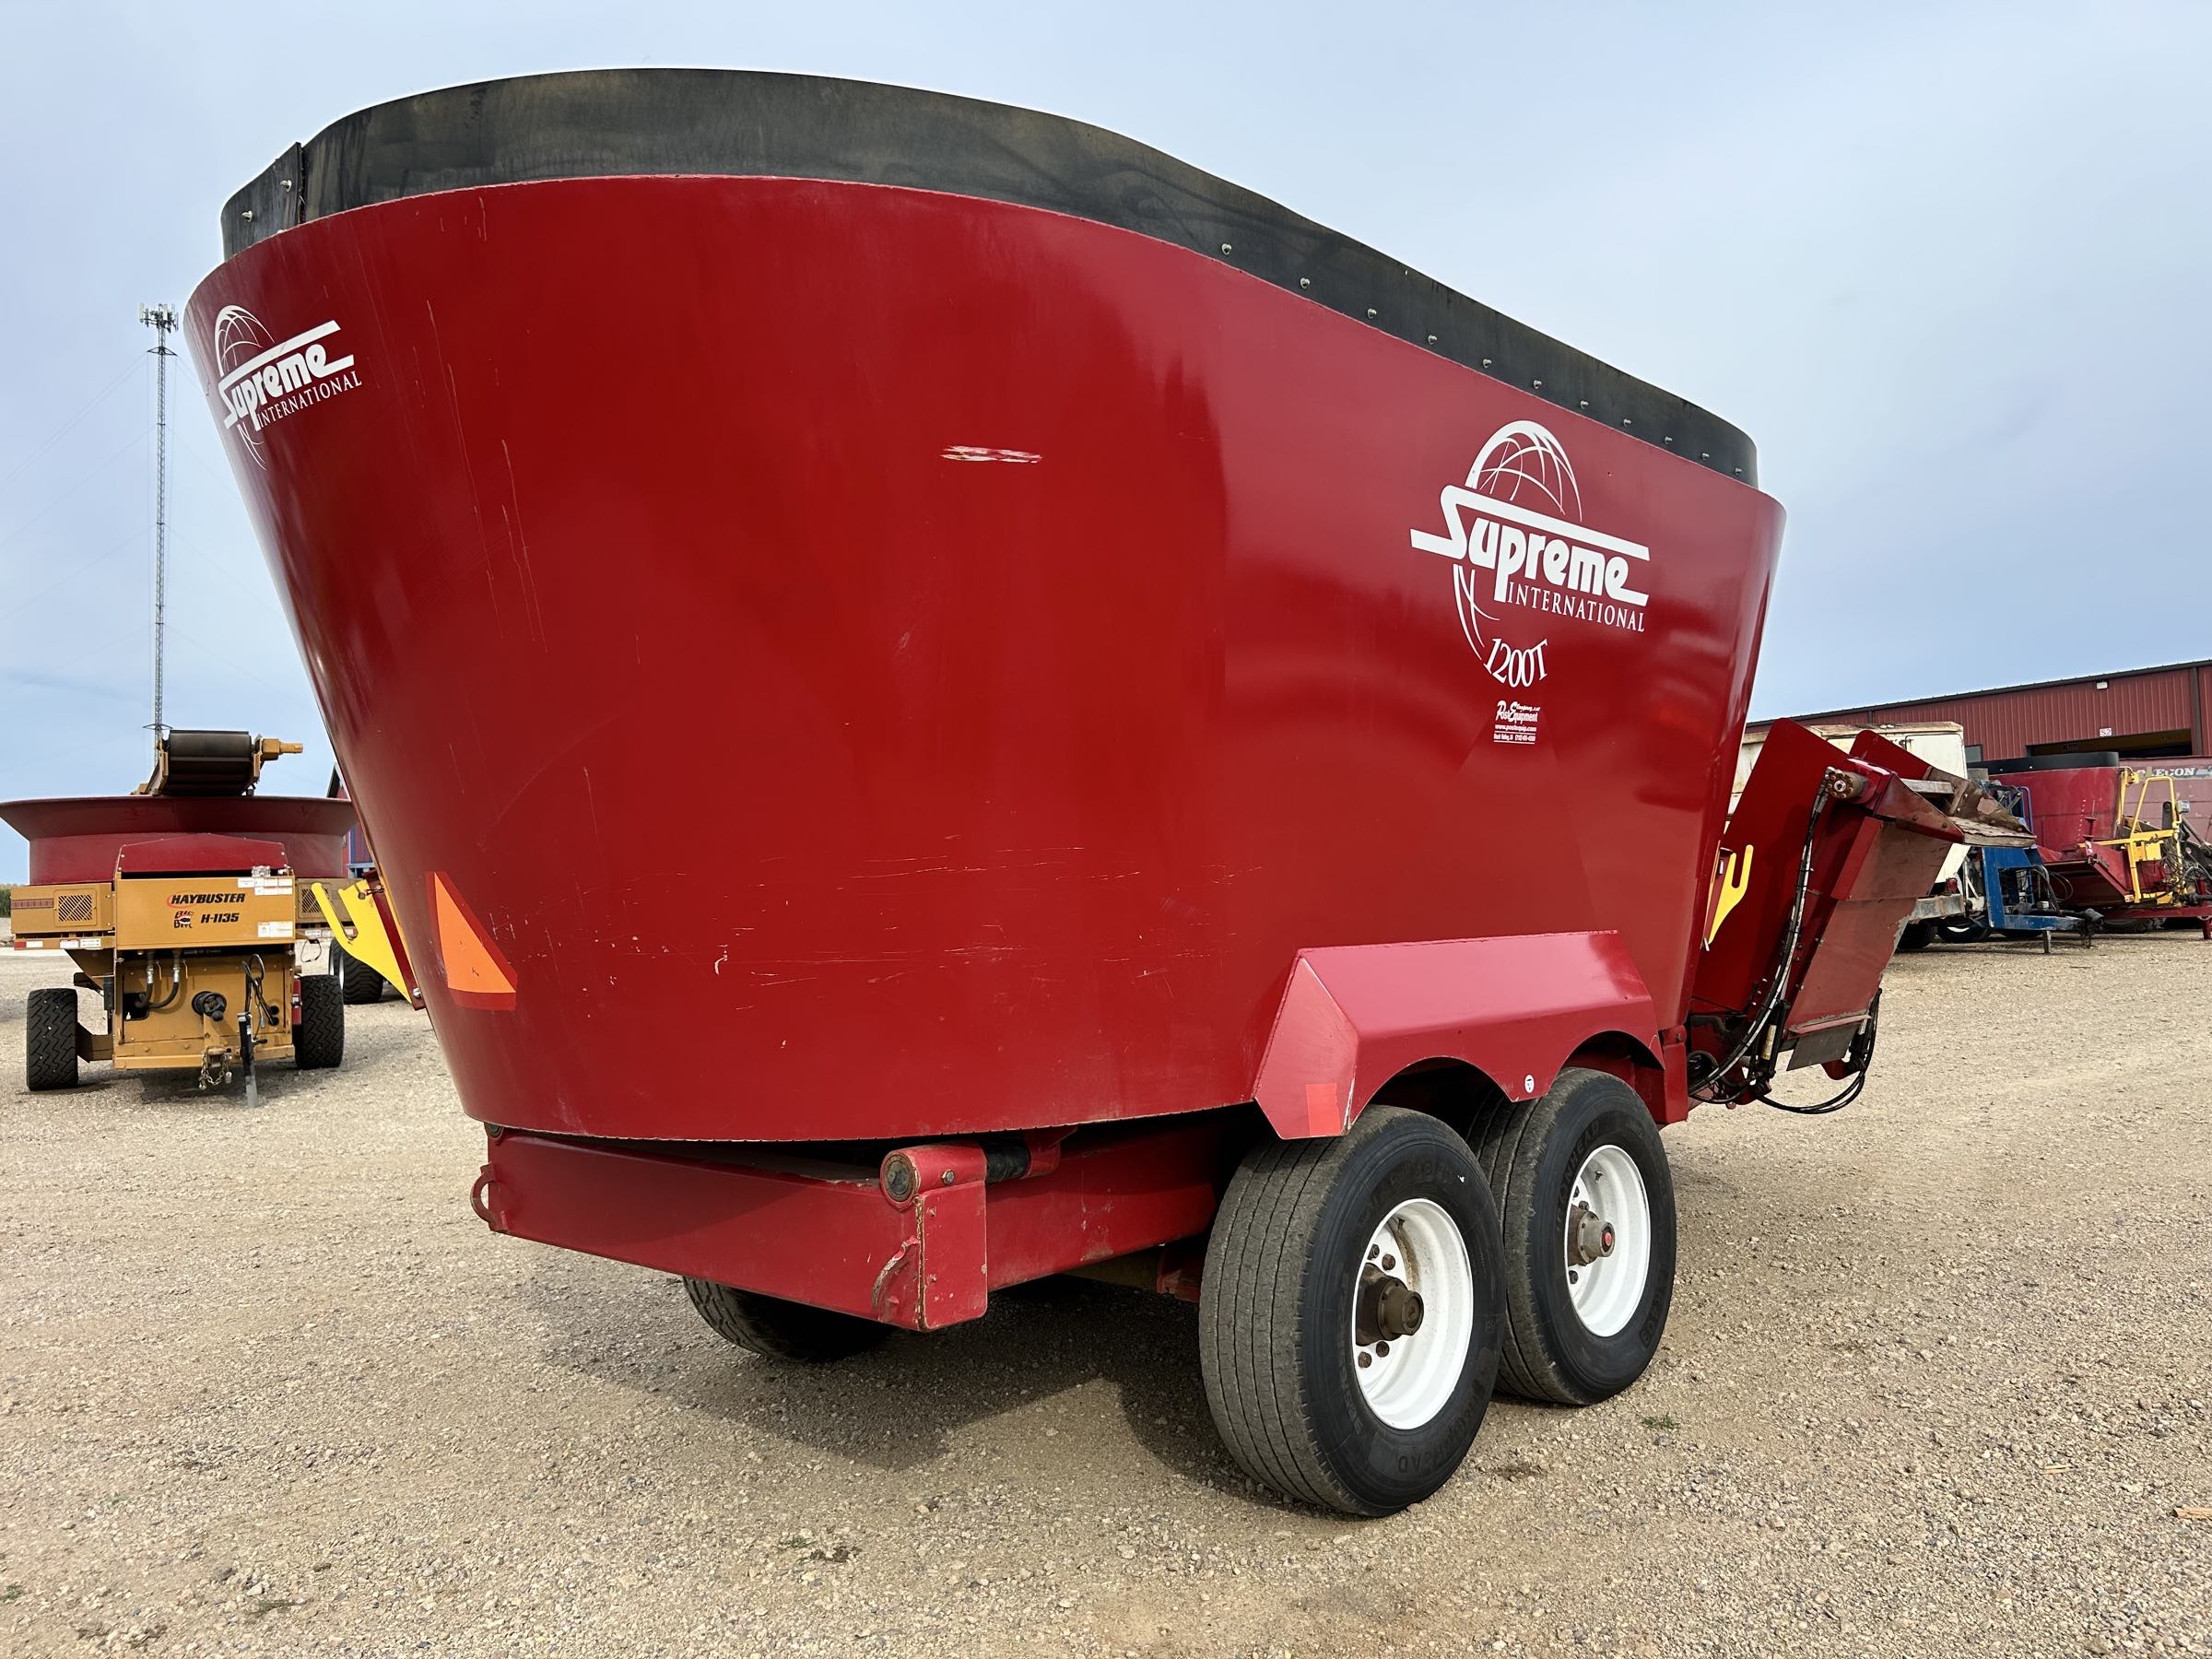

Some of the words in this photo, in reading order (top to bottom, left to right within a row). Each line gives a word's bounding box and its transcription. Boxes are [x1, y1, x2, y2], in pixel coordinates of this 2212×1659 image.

[218, 320, 355, 431] Supreme
[257, 371, 362, 428] INTERNATIONAL
[1410, 485, 1650, 606] Supreme
[1508, 582, 1645, 632] INTERNATIONAL
[1483, 638, 1548, 688] 1200T
[2100, 728, 2112, 736] S2
[171, 893, 246, 905] HAYBUSTER
[200, 912, 241, 924] H-1135
